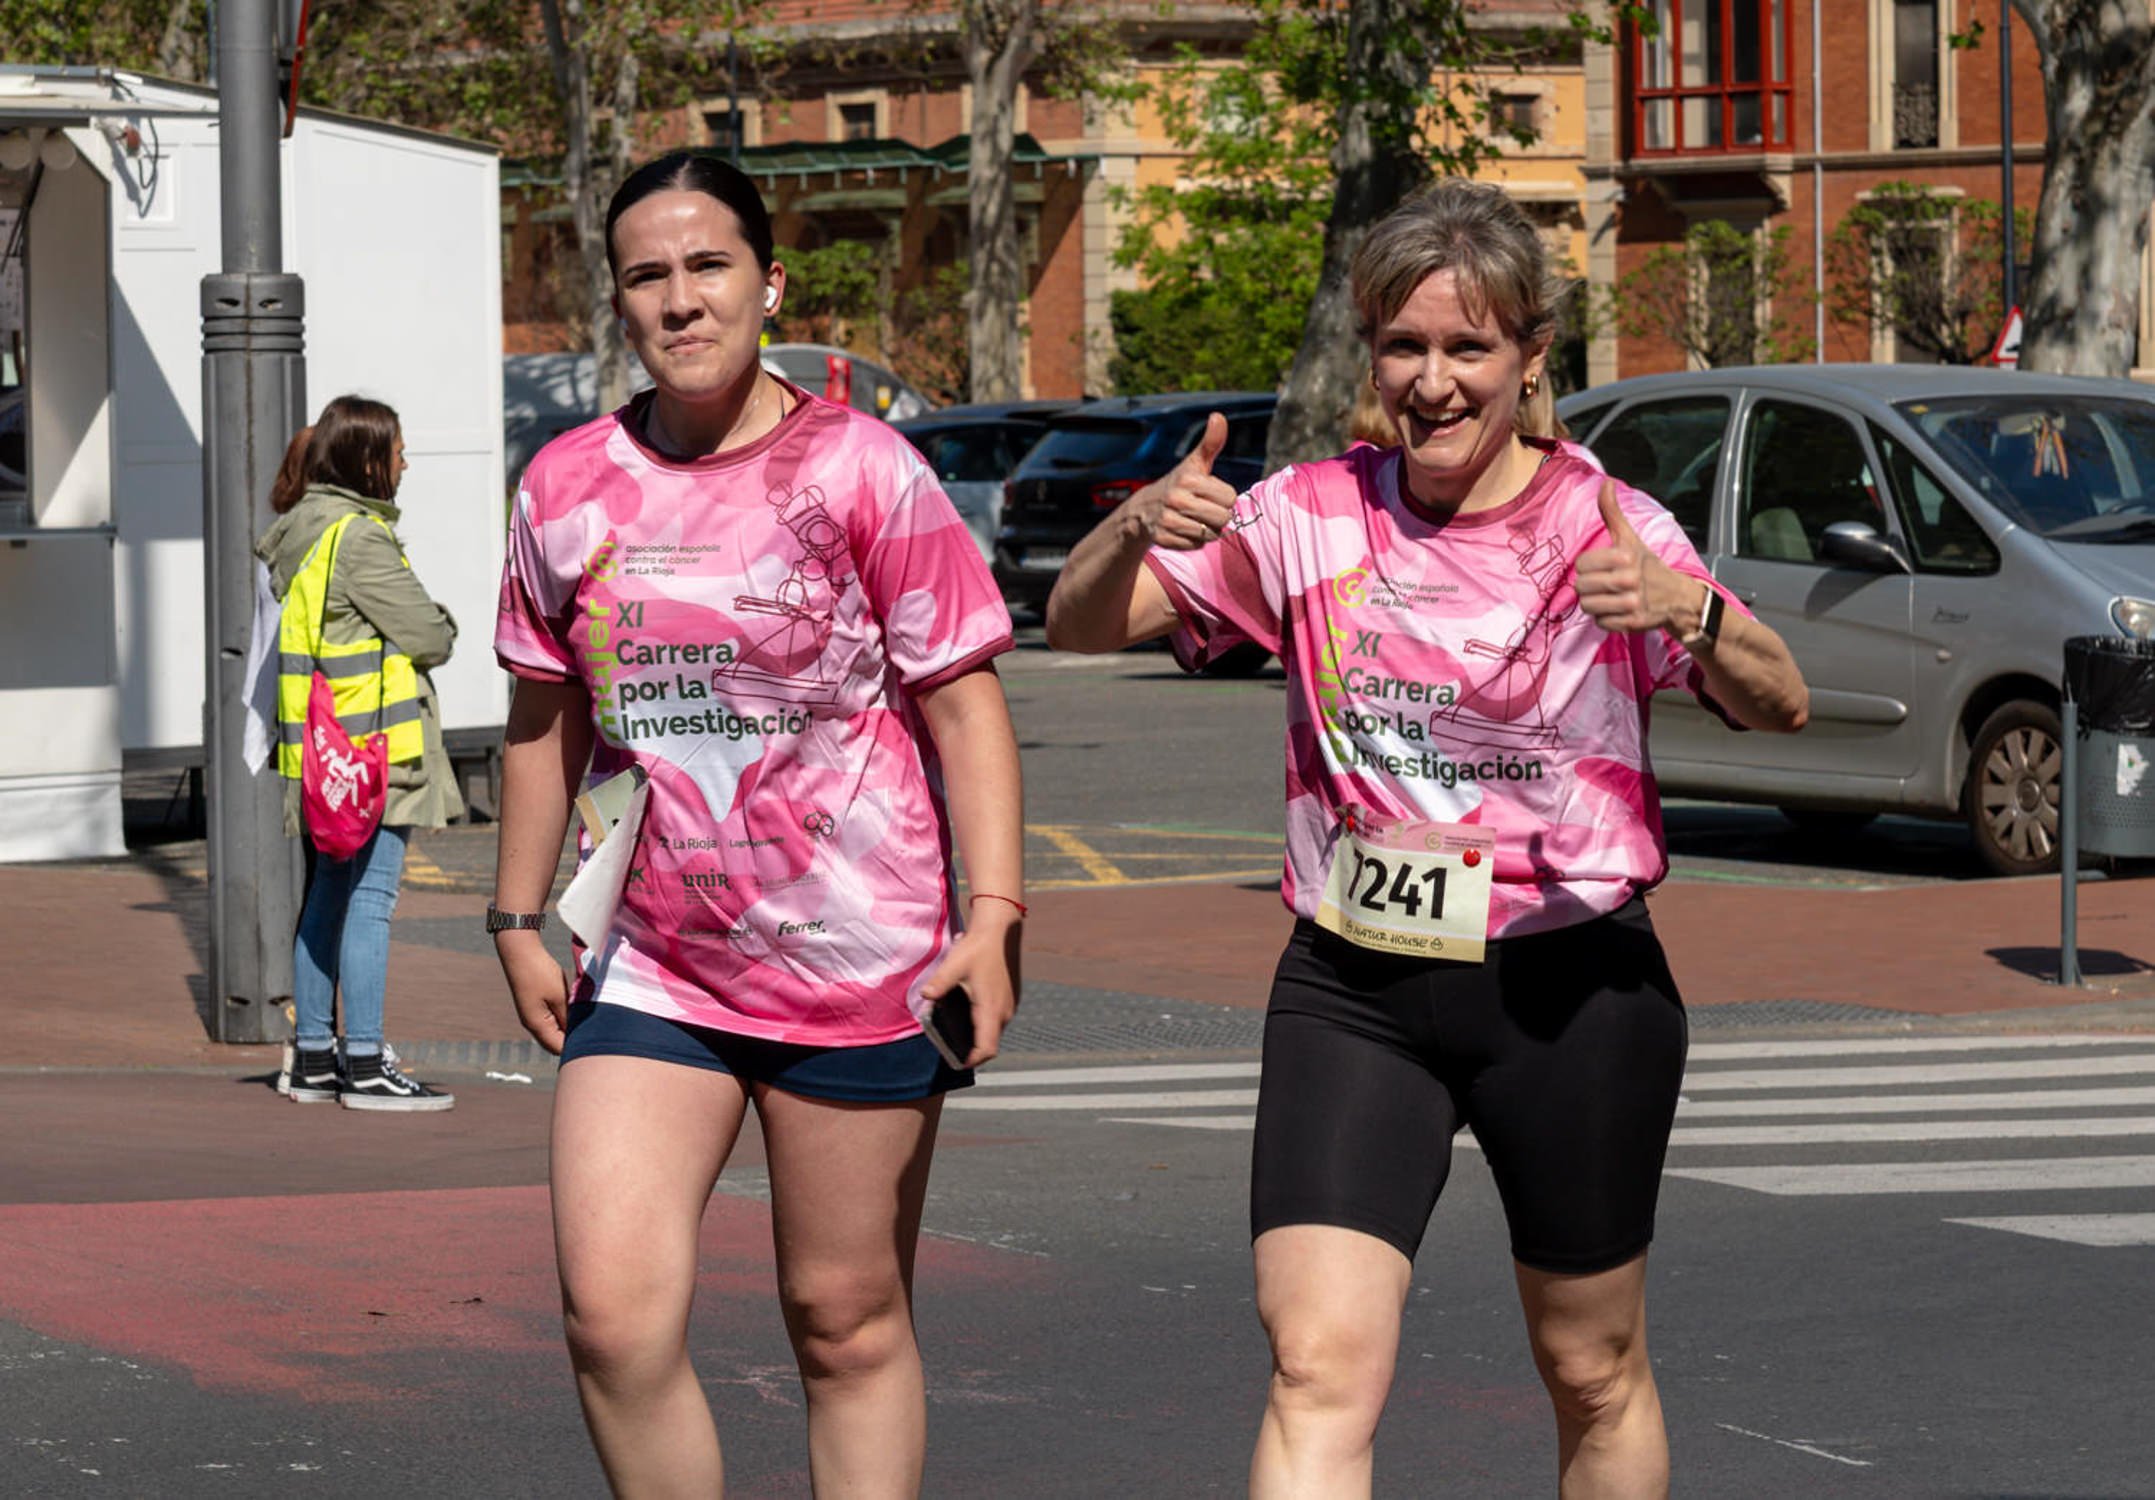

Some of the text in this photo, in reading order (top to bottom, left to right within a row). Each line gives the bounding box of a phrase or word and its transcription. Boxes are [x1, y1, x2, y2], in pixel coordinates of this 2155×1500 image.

[638, 567, 650, 575] La
[652, 567, 675, 576] Rioja
[615, 602, 644, 628] XI
[616, 639, 735, 666] Carrera
[1350, 629, 1383, 658] XI
[585, 599, 620, 741] mujer
[1343, 667, 1456, 706] Carrera
[618, 674, 707, 710] por la
[620, 707, 813, 741] Investigación
[1344, 709, 1424, 741] por la
[1351, 740, 1543, 789] Investigación
[673, 838, 685, 850] La
[687, 836, 718, 851] Rioja
[1348, 847, 1447, 920] 7241
